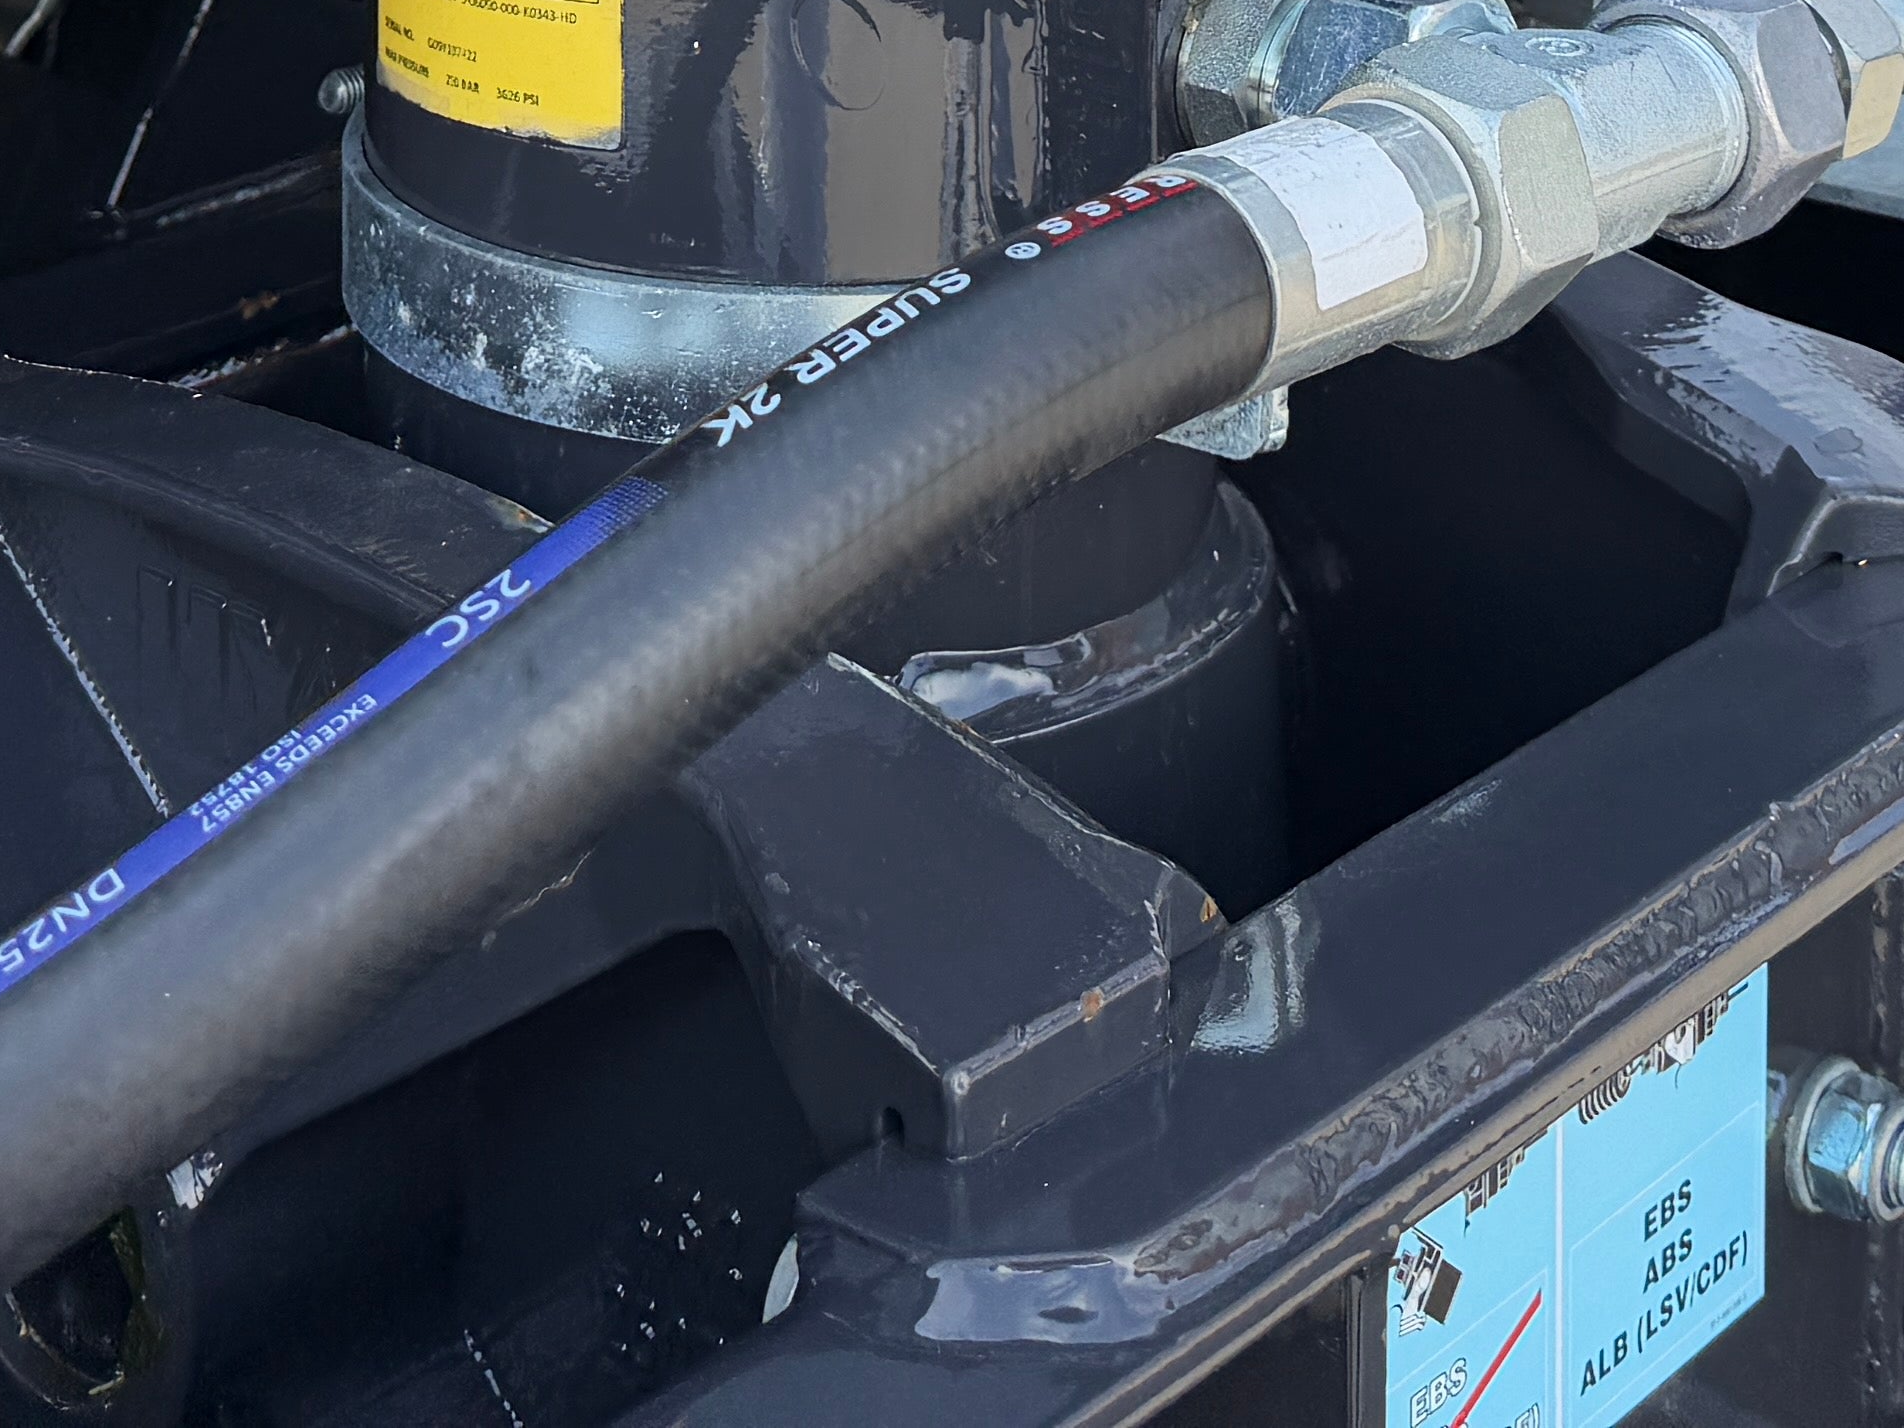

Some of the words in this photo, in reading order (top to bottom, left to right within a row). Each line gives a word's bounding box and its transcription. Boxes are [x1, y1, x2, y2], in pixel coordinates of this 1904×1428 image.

[1037, 175, 1186, 236] RESS
[786, 267, 971, 385] SUPER
[700, 382, 782, 448] 2K
[425, 568, 532, 648] 2SC
[262, 728, 302, 762] ISO
[275, 694, 378, 772] EXCEEDS
[190, 763, 258, 817] 18752
[201, 773, 276, 833] EN857
[1644, 1178, 1692, 1242] EBS
[1642, 1227, 1693, 1294] ABS
[1580, 1330, 1628, 1397] ALB
[1637, 1229, 1748, 1354] (LSV/CDF)
[1410, 1357, 1468, 1428] EBS
